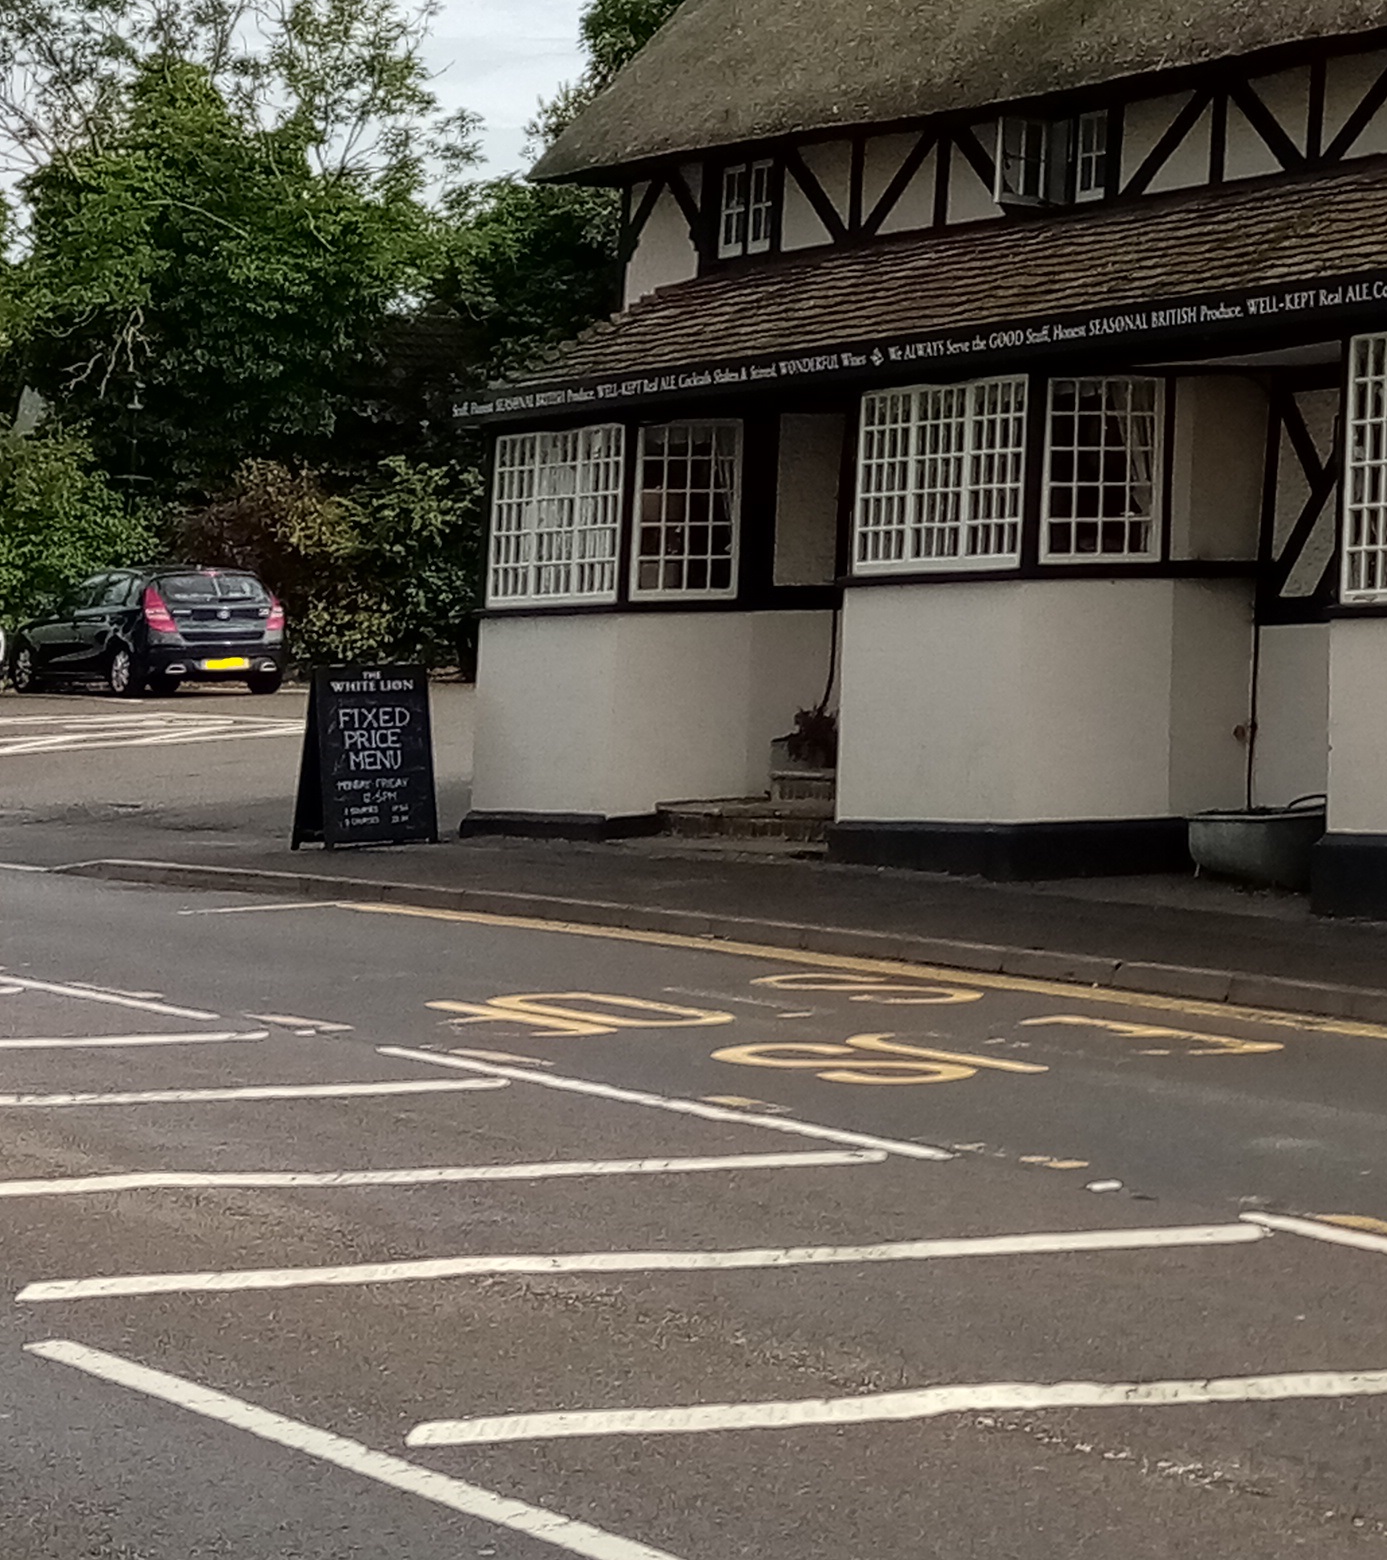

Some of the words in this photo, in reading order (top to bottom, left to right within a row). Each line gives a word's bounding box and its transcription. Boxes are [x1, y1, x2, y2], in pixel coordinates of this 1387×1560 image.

[946, 338, 970, 355] Serve
[971, 334, 987, 352] the
[989, 330, 1024, 350] GOOD
[1088, 312, 1149, 336] SEASONAL
[1150, 306, 1198, 329] BRITISH
[1246, 289, 1318, 316] WELL-KEPT
[1318, 285, 1344, 307] Real
[329, 680, 377, 693] WHITE
[379, 679, 414, 691] LION
[362, 671, 382, 680] THE
[338, 706, 411, 730] FIXED
[343, 728, 403, 750] PRICE
[348, 749, 402, 771] MENU
